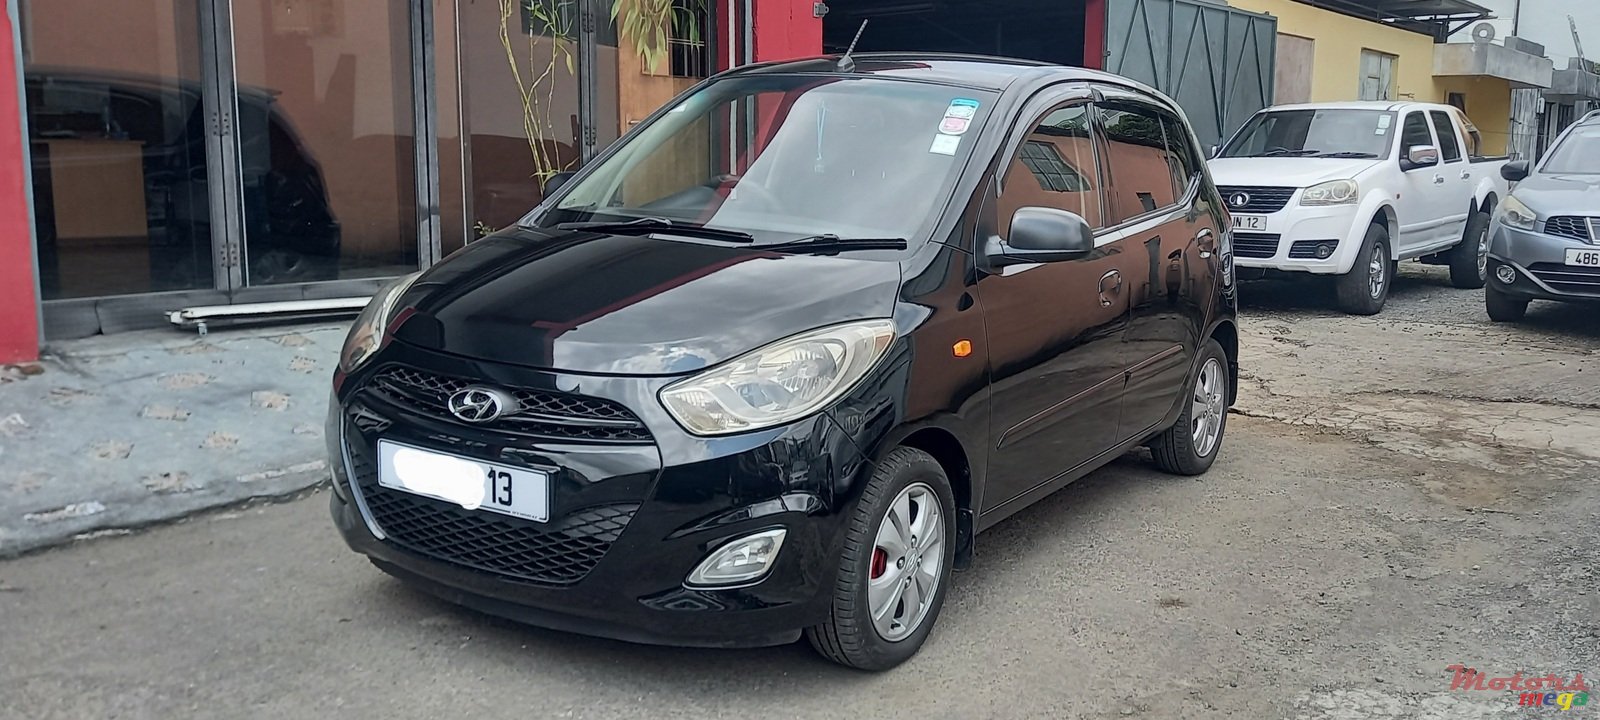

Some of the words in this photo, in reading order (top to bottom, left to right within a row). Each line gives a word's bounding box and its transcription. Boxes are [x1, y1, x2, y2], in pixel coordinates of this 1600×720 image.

[1247, 217, 1259, 228] 12
[1575, 252, 1599, 265] 486
[487, 469, 512, 507] 13
